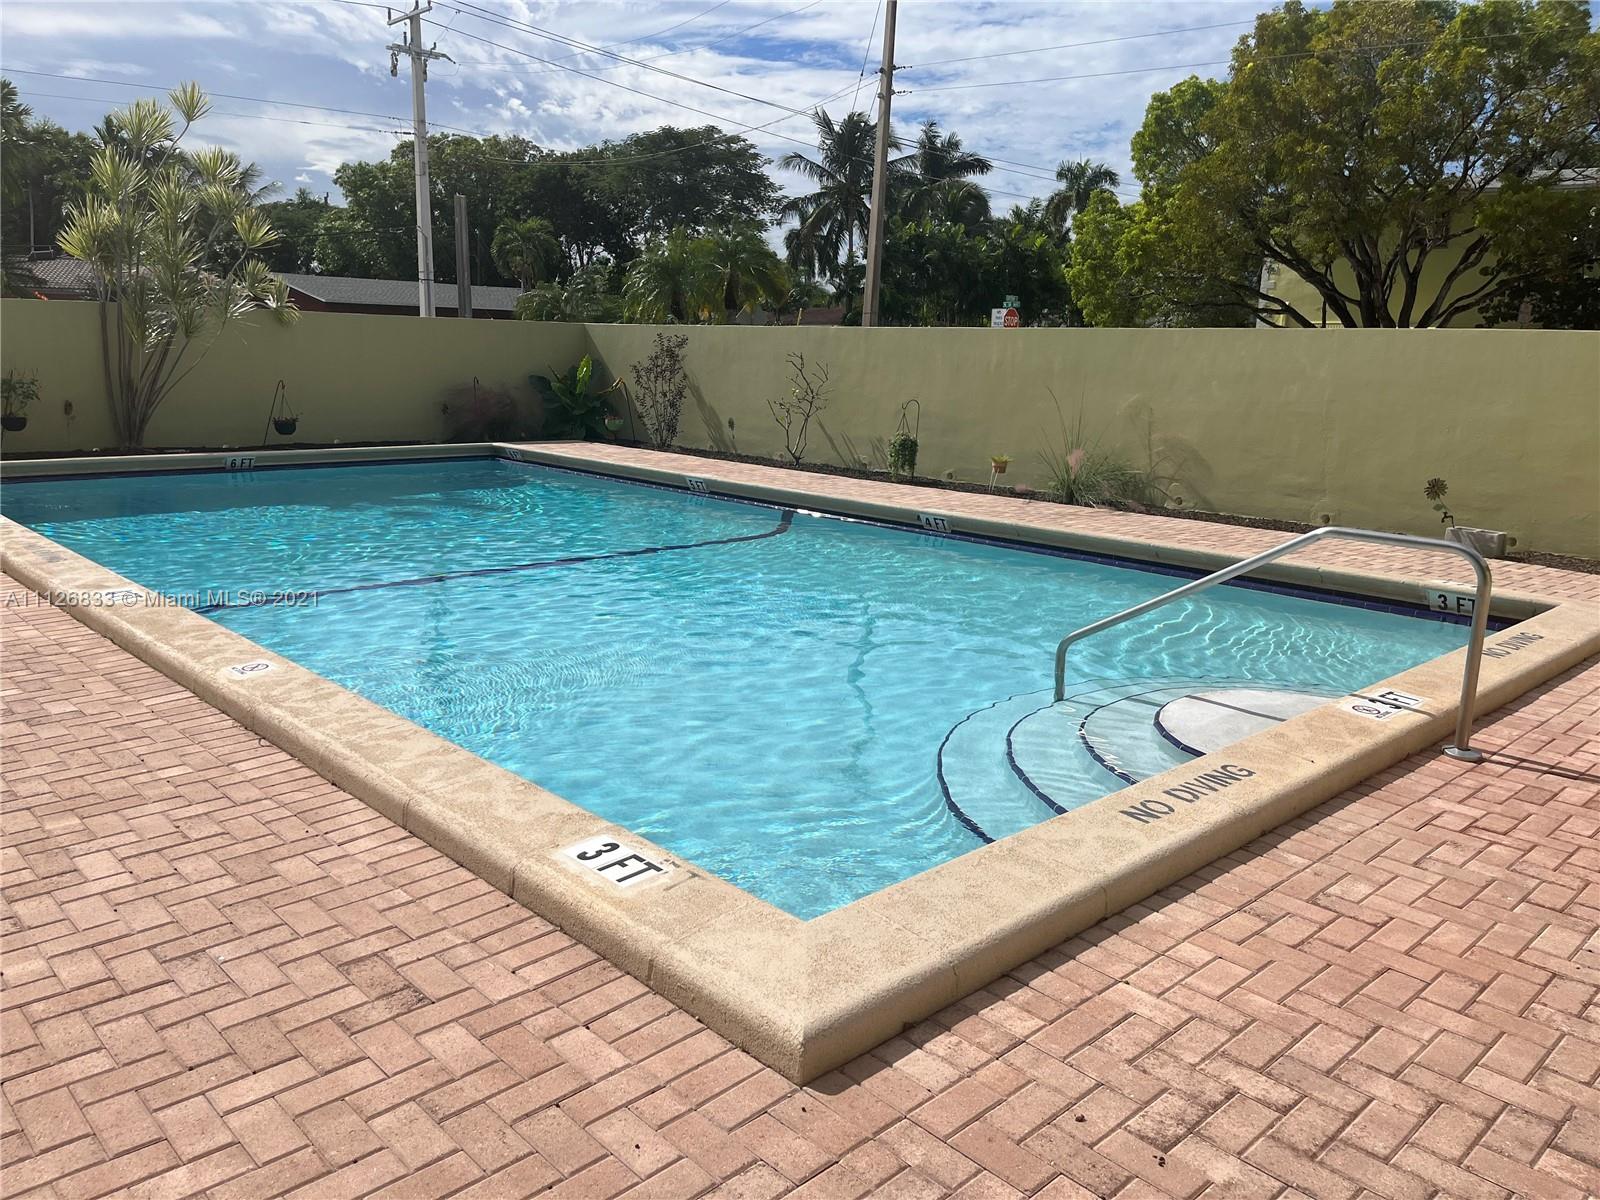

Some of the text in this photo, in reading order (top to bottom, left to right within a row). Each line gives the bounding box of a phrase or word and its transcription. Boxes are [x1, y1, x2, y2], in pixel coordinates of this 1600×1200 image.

[1004, 316, 1018, 327] STOP
[230, 458, 255, 468] 6 FT
[694, 480, 706, 491] FT
[925, 517, 947, 531] 4 FT
[1437, 594, 1477, 614] 3 FT
[1482, 631, 1545, 659] NO DIVING
[1368, 691, 1420, 710] 3 FT
[1119, 764, 1257, 824] NO DIVING
[576, 842, 664, 883] 3 FT
